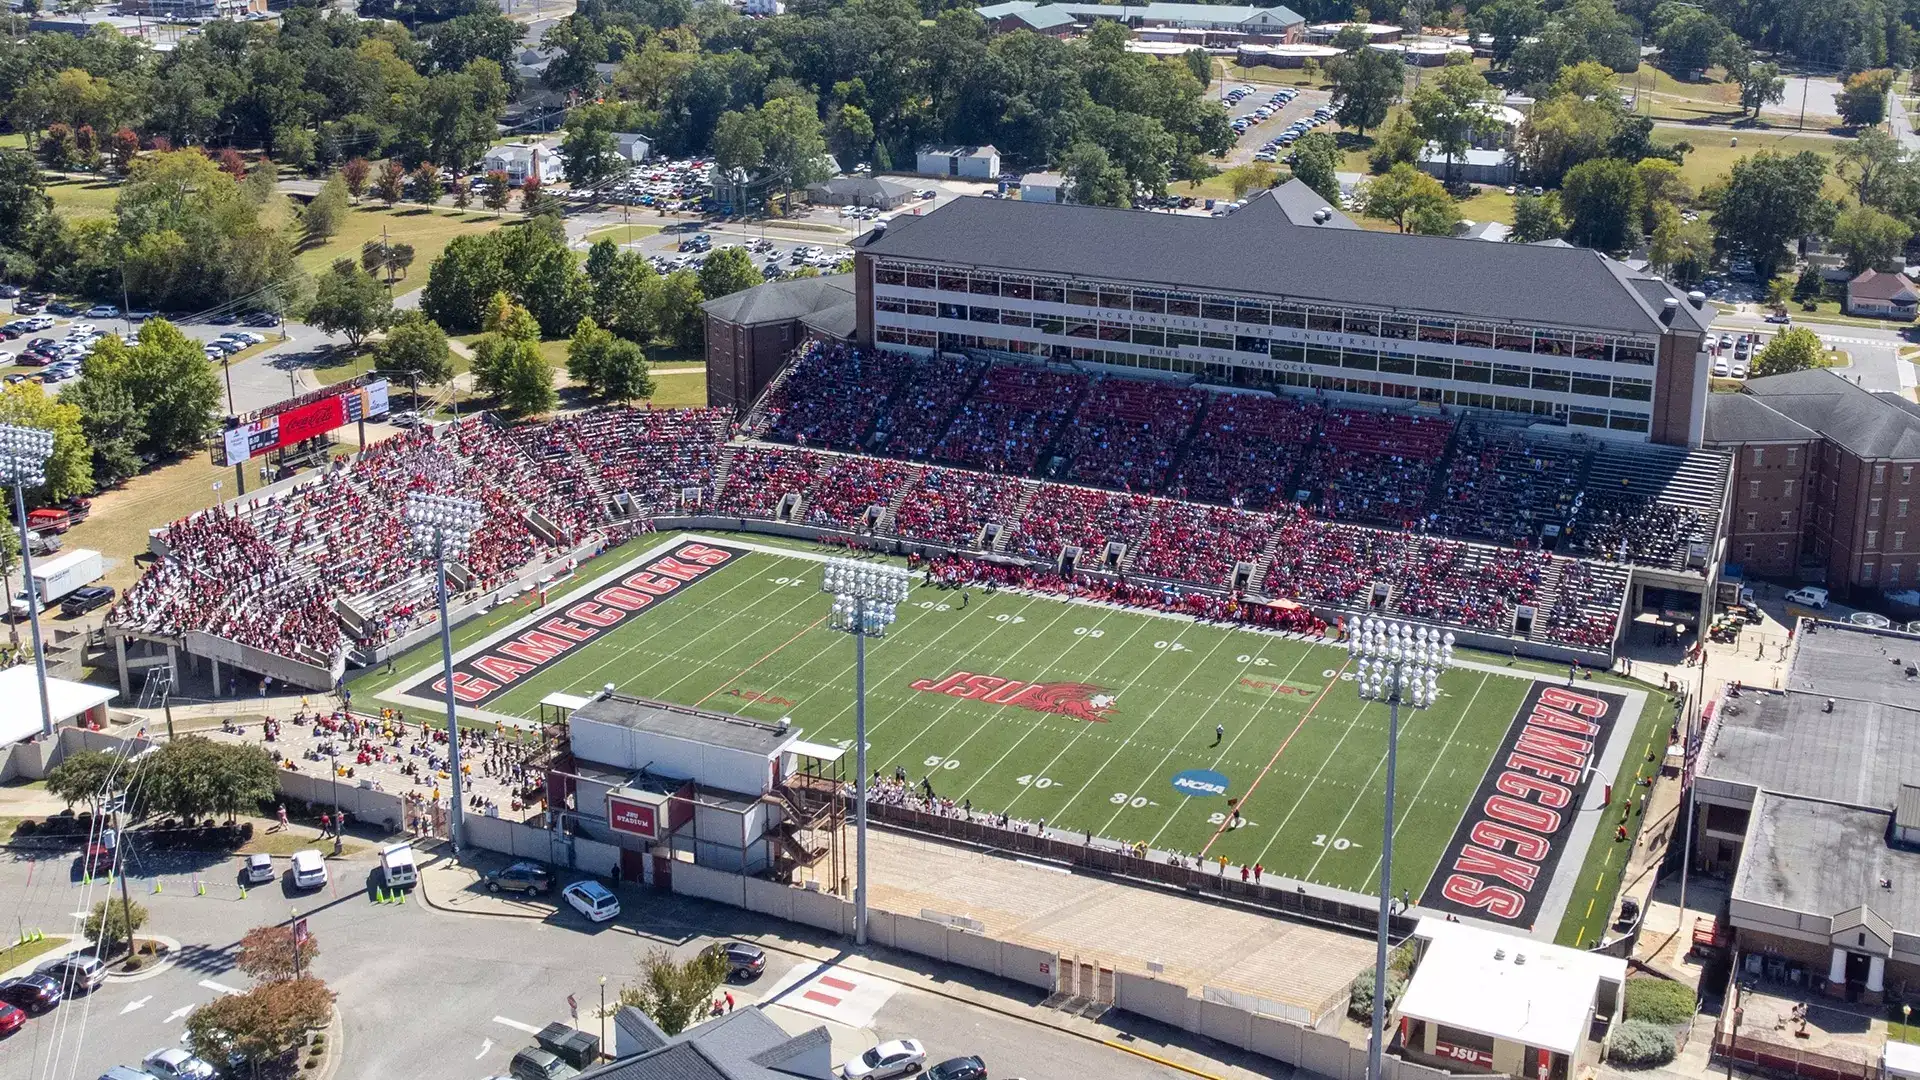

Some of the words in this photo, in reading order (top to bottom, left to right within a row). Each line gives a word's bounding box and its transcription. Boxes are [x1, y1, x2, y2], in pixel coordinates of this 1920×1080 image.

[1087, 310, 1208, 329] JACKSONVILLE
[1223, 324, 1274, 336] STATE
[1292, 332, 1400, 349] UNIVERSITY
[1149, 348, 1181, 358] HOME
[1210, 355, 1232, 364] THE
[1242, 359, 1314, 373] GAMECOCKS
[431, 544, 733, 702] GAMECOCKS
[908, 670, 1043, 706] JSU
[923, 754, 961, 769] 50
[1016, 774, 1052, 789] 40
[1174, 778, 1226, 794] NCAA
[1109, 793, 1148, 808] 30
[1441, 686, 1609, 919] GAMECOCKS
[616, 815, 648, 827] STADIUM
[1312, 834, 1351, 850] 10
[1450, 1046, 1478, 1062] JSU
